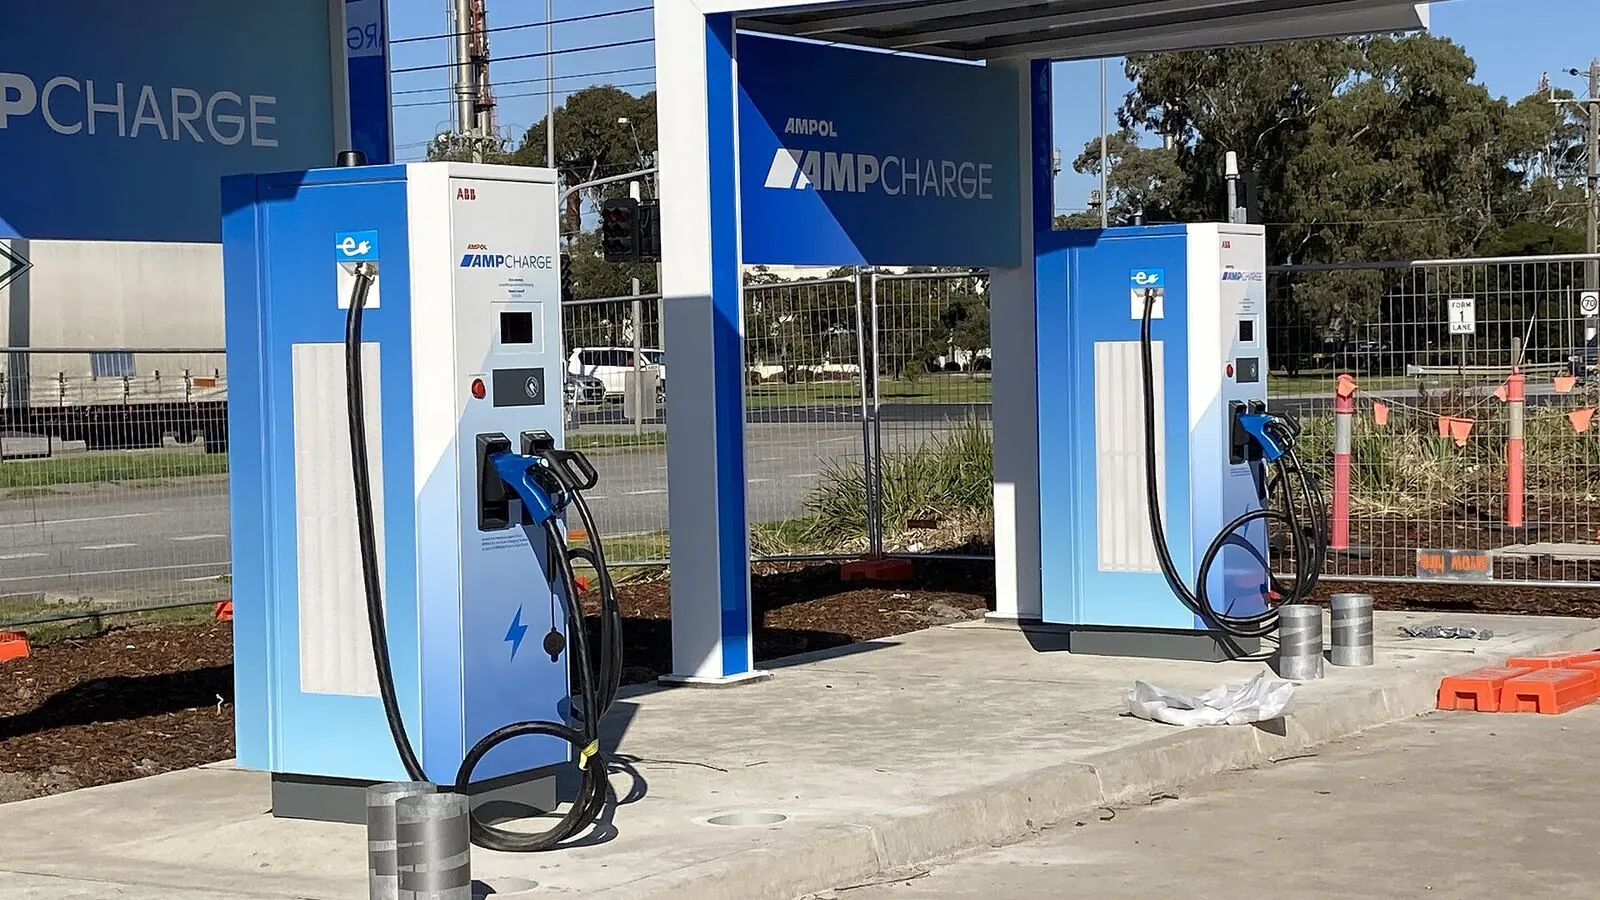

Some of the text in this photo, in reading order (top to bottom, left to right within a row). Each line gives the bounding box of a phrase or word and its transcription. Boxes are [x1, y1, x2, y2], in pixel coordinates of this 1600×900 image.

[784, 117, 838, 137] AMPOL
[794, 150, 993, 200] AMPCHARGE
[456, 188, 476, 201] ABB
[471, 254, 553, 270] AMPCHARGE
[1451, 301, 1472, 309] FORM
[1584, 298, 1596, 308] 70
[1459, 310, 1465, 323] 1
[1452, 323, 1472, 331] LANE
